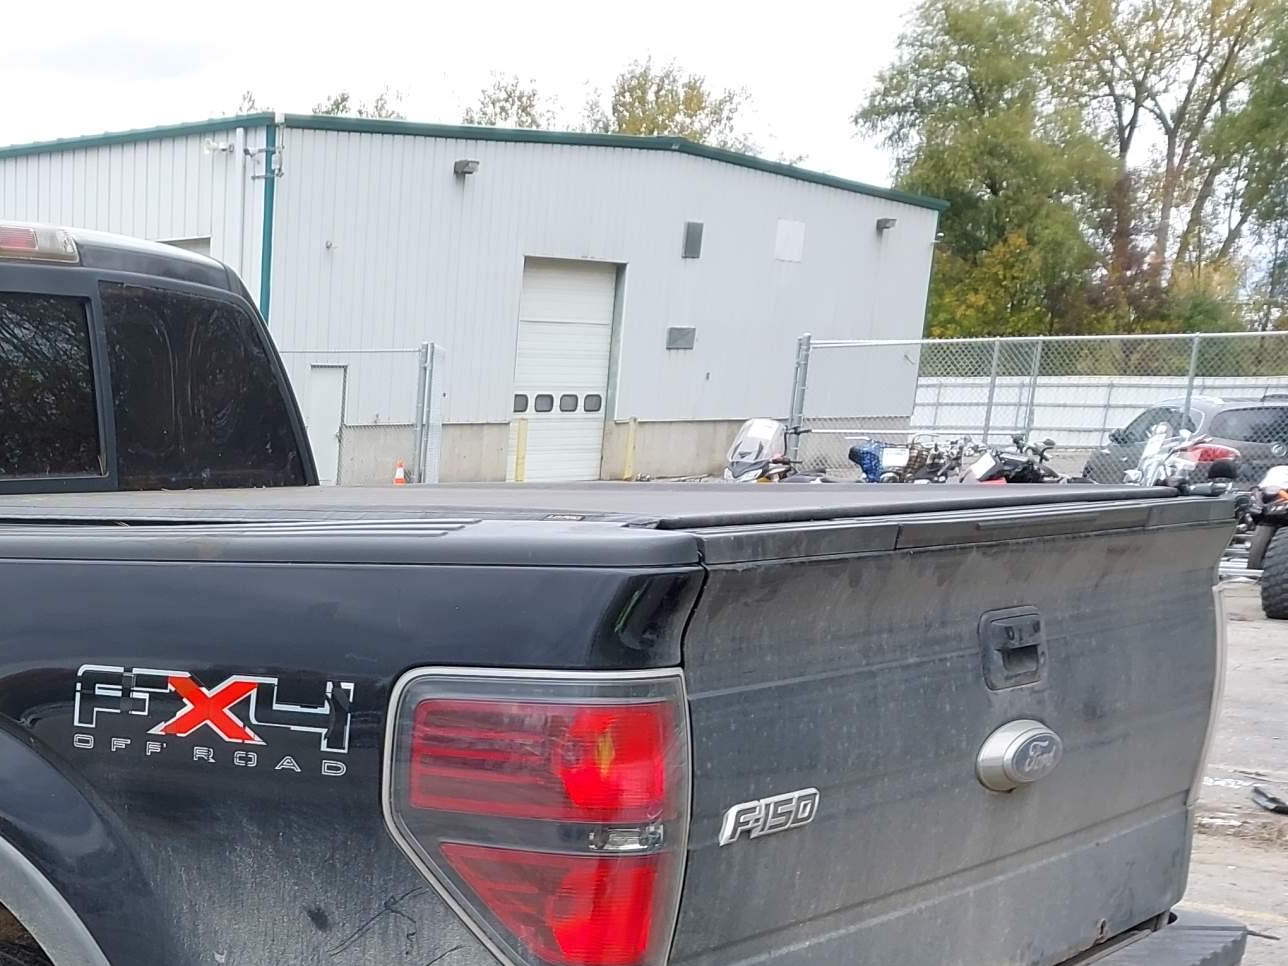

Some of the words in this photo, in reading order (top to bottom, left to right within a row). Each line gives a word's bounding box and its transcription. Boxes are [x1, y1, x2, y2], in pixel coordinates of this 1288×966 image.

[74, 664, 355, 753] FX4
[73, 734, 167, 756] OFF
[193, 746, 347, 776] ROAD
